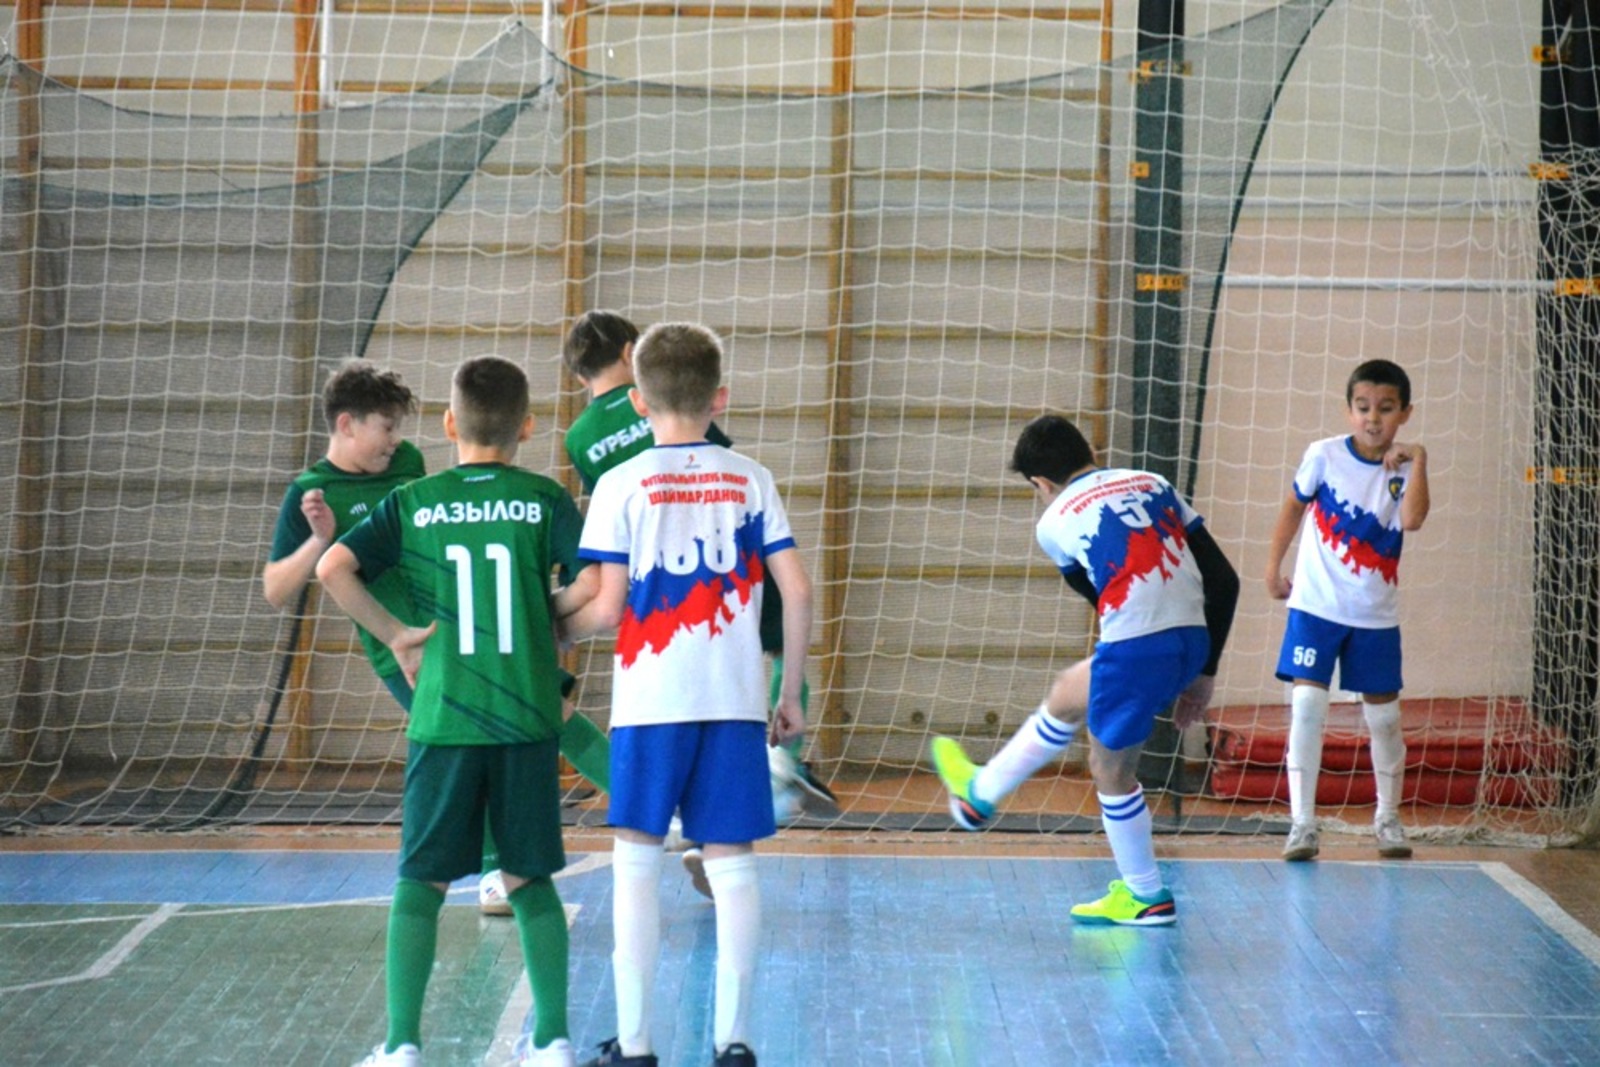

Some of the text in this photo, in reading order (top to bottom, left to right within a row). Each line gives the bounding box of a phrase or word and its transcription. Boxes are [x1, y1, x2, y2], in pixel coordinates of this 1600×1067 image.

[699, 472, 721, 484] КЛУБ
[648, 487, 746, 506] ШАЙМАРДАНОВ
[413, 500, 543, 528] ФАЗЫЛОВ
[1108, 492, 1153, 528] 5
[445, 543, 513, 655] 11
[1292, 645, 1317, 668] 56
